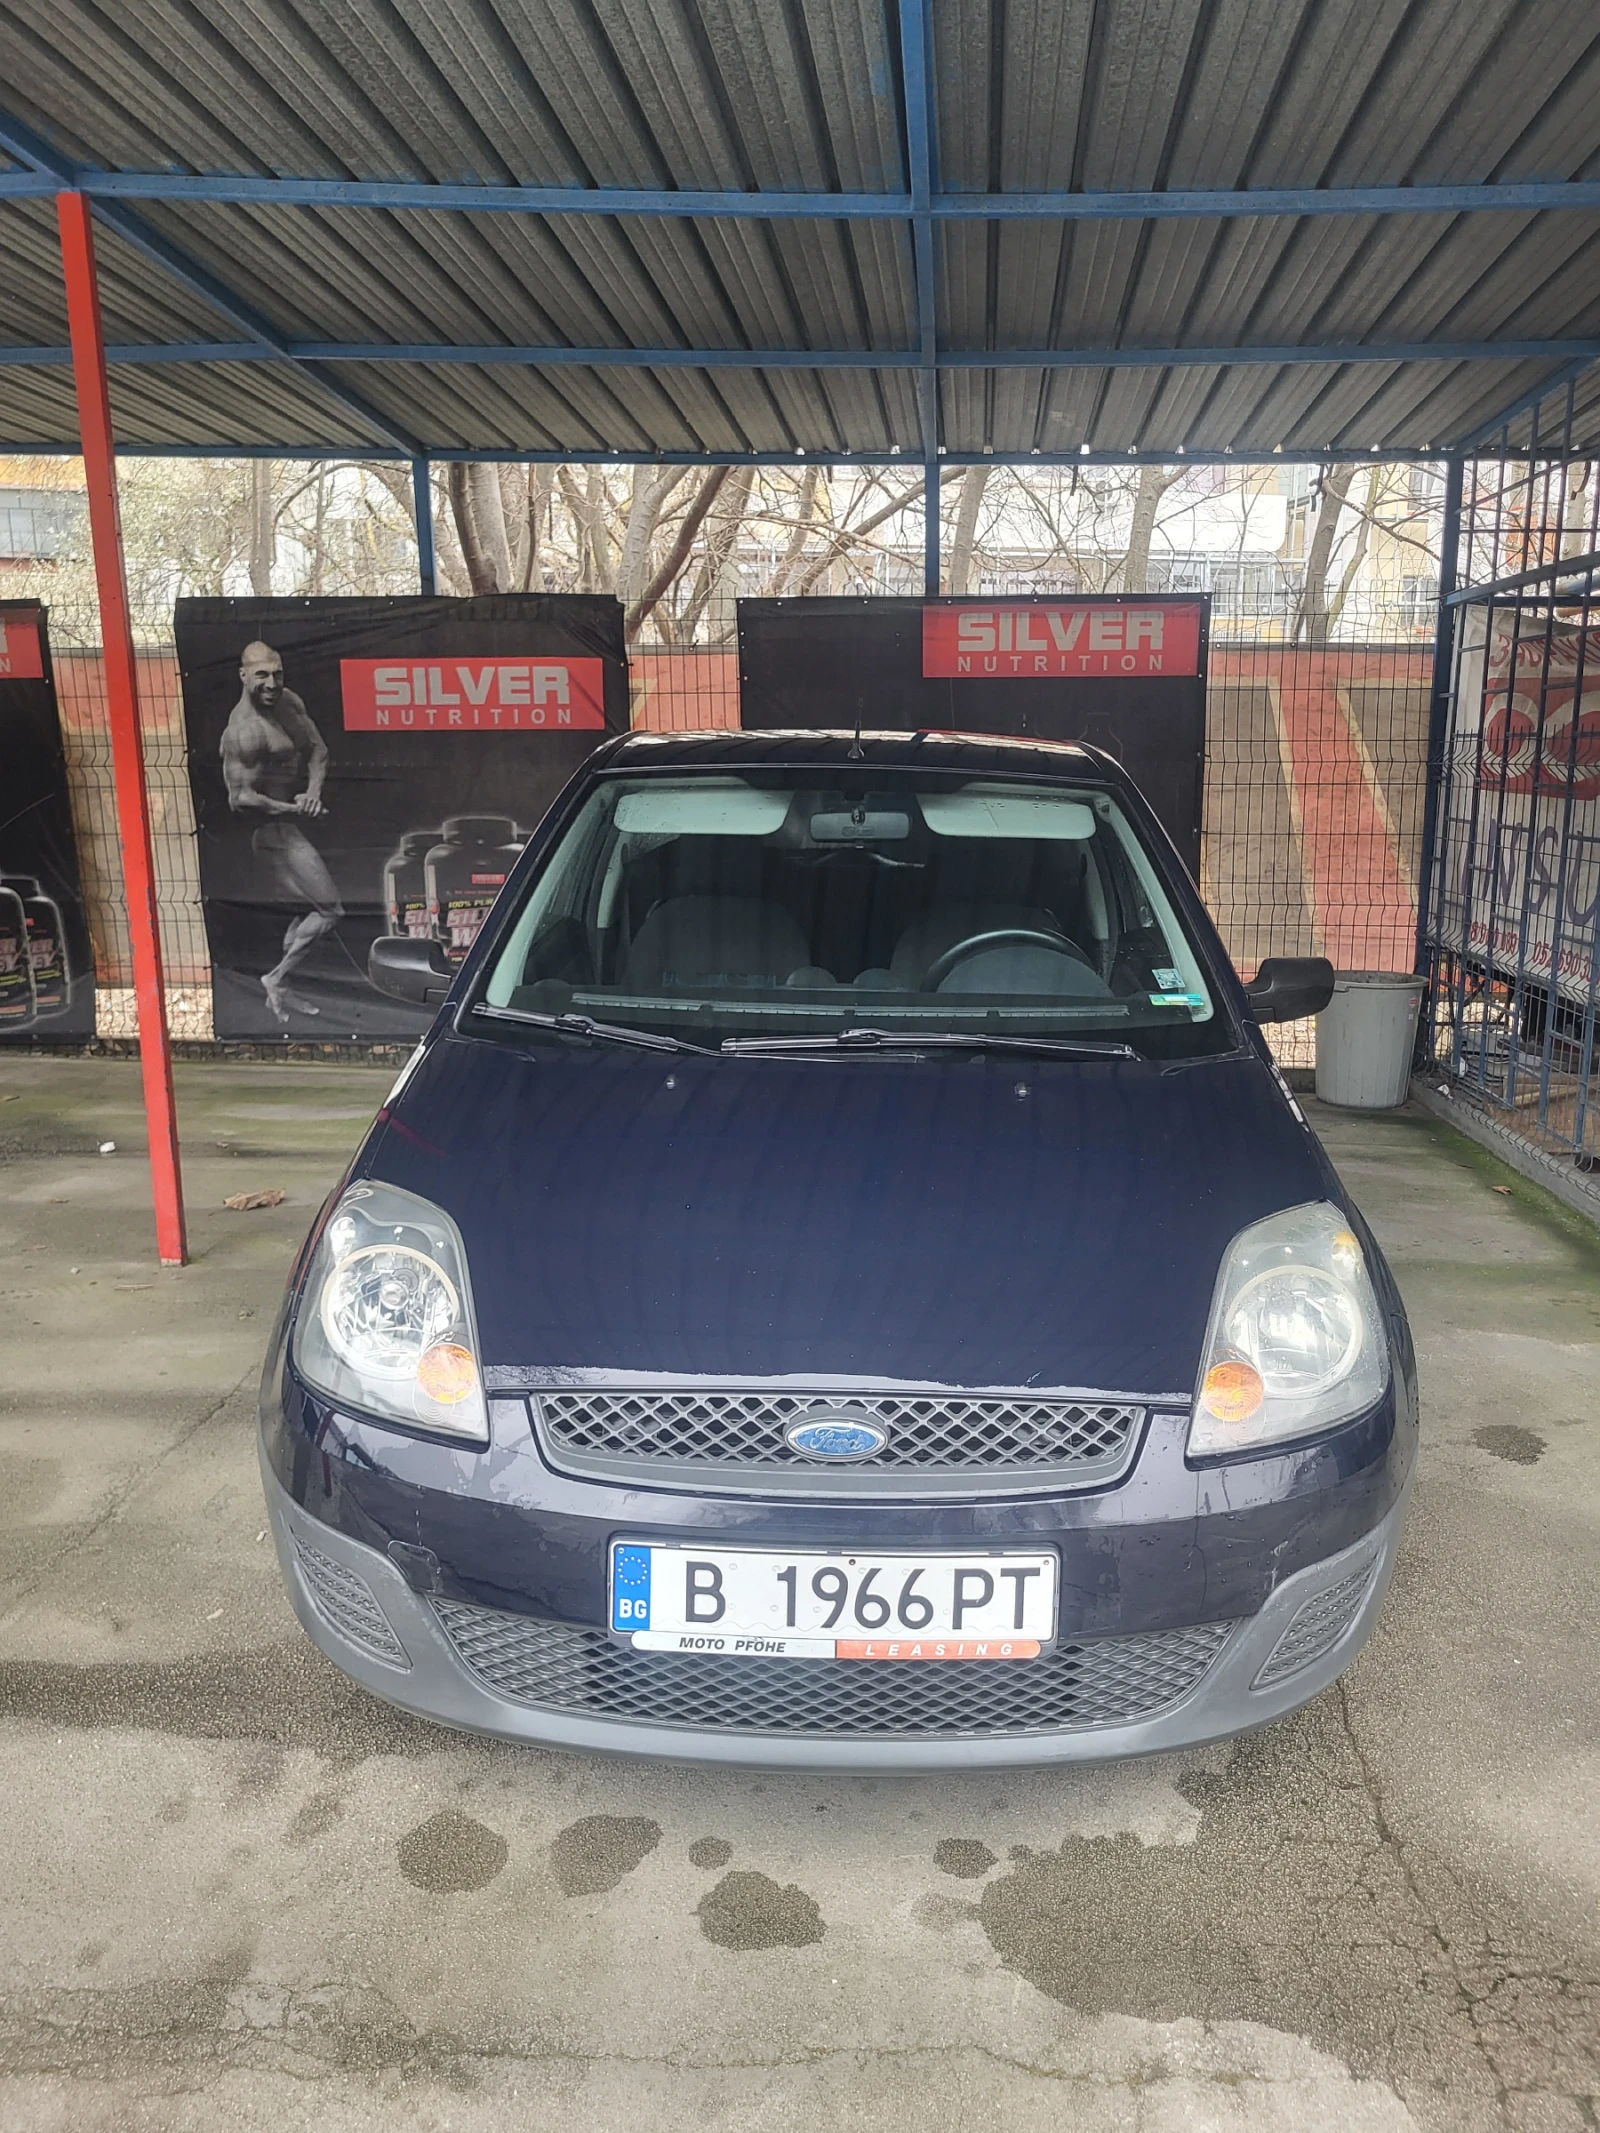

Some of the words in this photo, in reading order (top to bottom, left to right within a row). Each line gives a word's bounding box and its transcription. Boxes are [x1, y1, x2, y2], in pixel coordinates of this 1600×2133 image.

[957, 611, 1165, 652] SILVER
[957, 655, 1163, 672] NUTRITION
[374, 666, 571, 706] SILVER
[376, 708, 572, 726] NUTRITION
[809, 1426, 866, 1453] Ford
[686, 1561, 726, 1623] B
[777, 1566, 934, 1630] 1966
[952, 1567, 1041, 1630] PT
[619, 1598, 647, 1619] BG
[679, 1637, 725, 1650] MOTO
[735, 1640, 786, 1653] PFOHE
[865, 1644, 1013, 1656] LEASING
